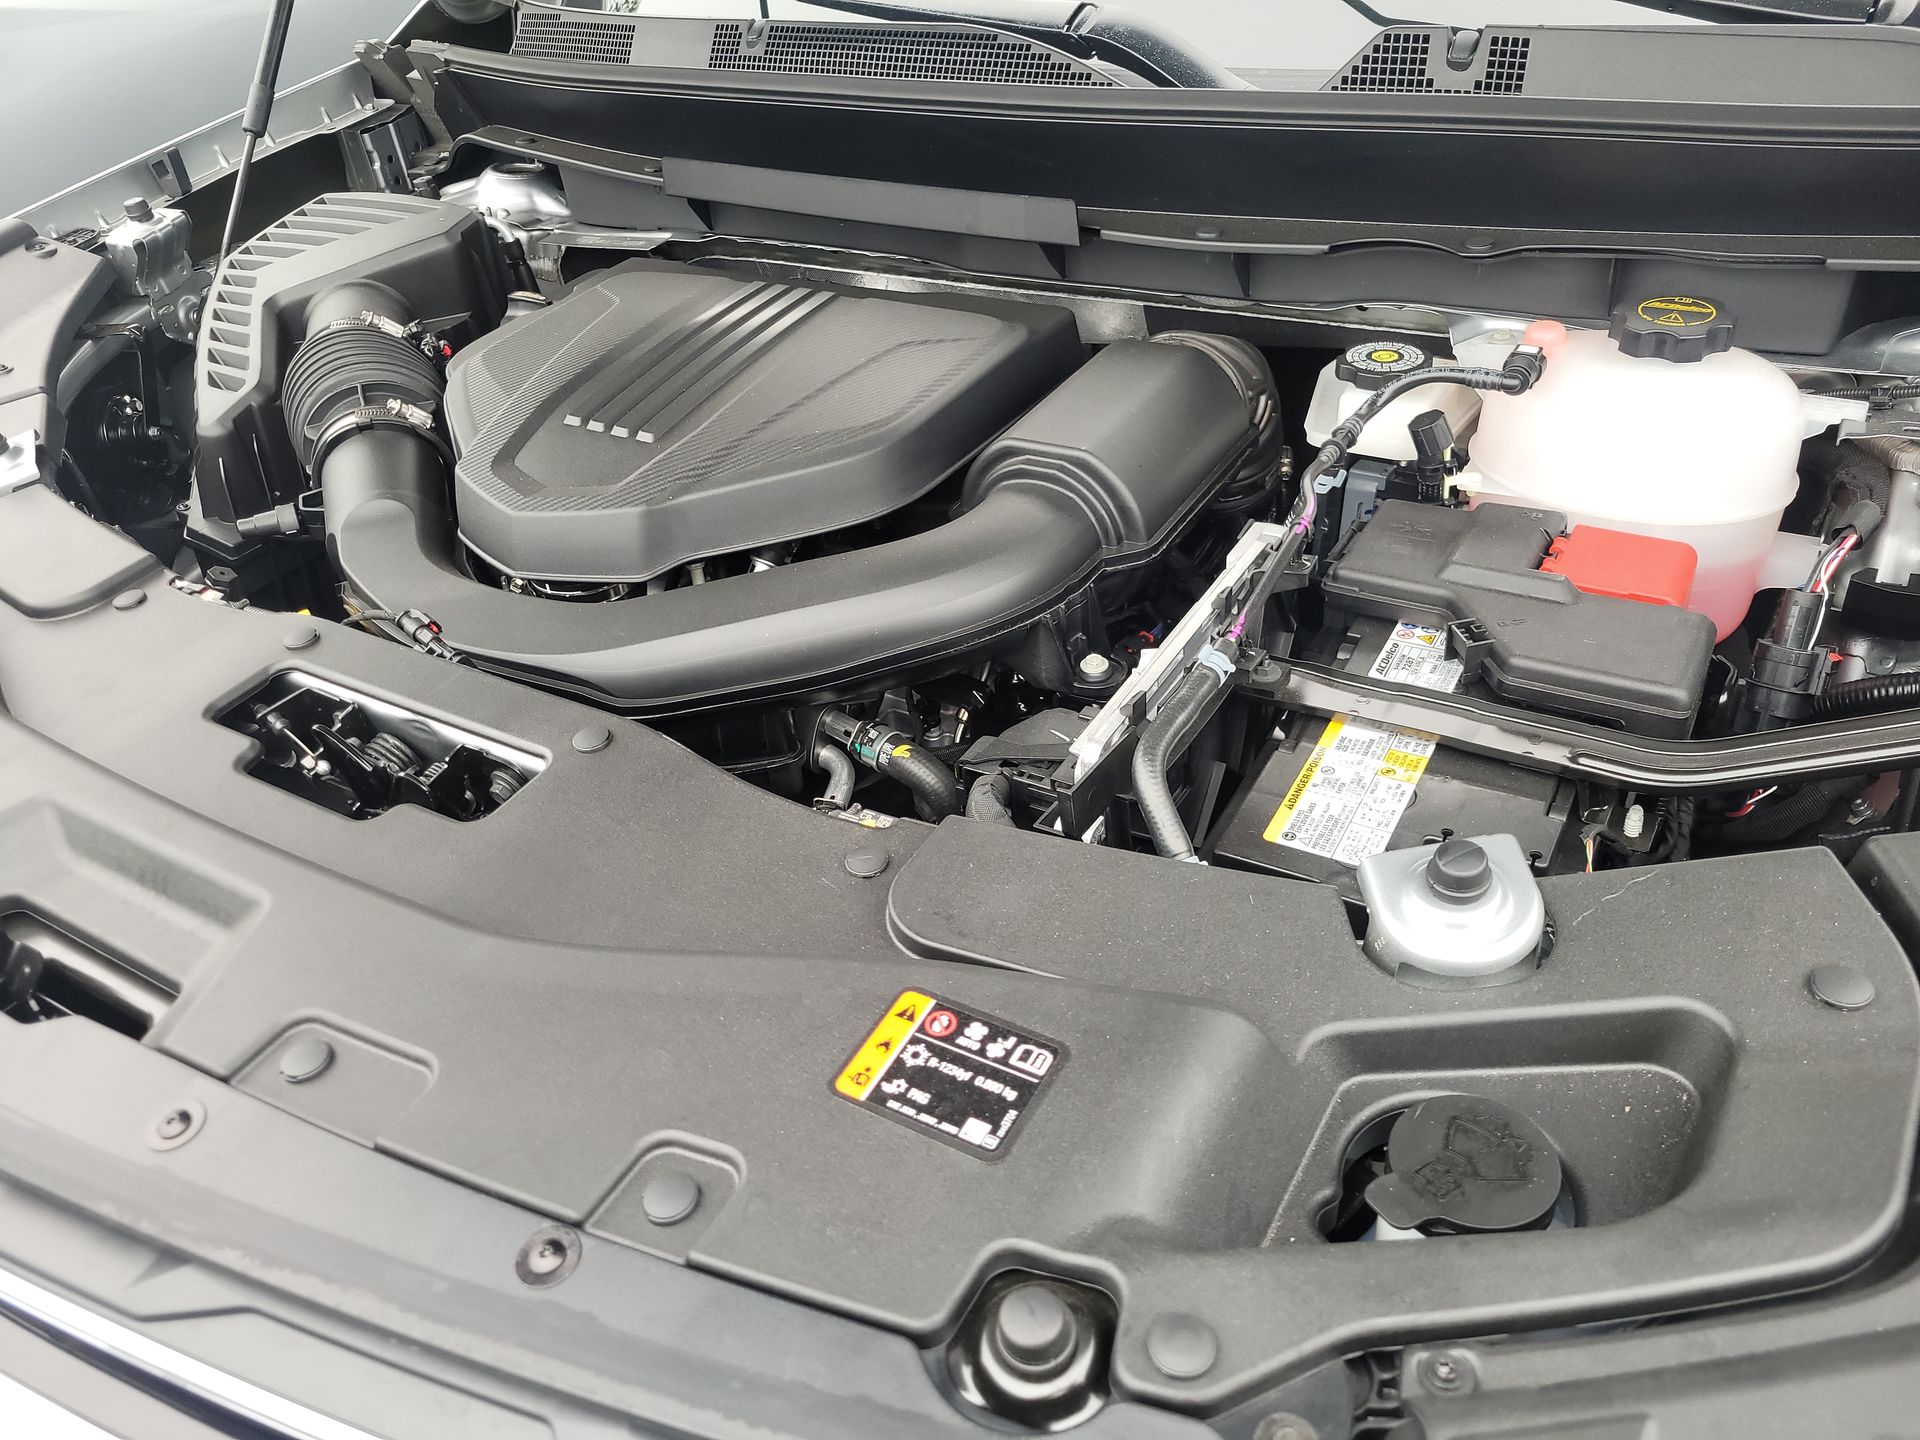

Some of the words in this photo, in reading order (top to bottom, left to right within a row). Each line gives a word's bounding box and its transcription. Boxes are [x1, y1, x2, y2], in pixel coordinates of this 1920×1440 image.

[1648, 302, 1713, 313] ACDelco
[1376, 643, 1399, 675] ACDelco
[1401, 656, 1415, 671] 7287
[1287, 746, 1327, 804] DANGER/POISON
